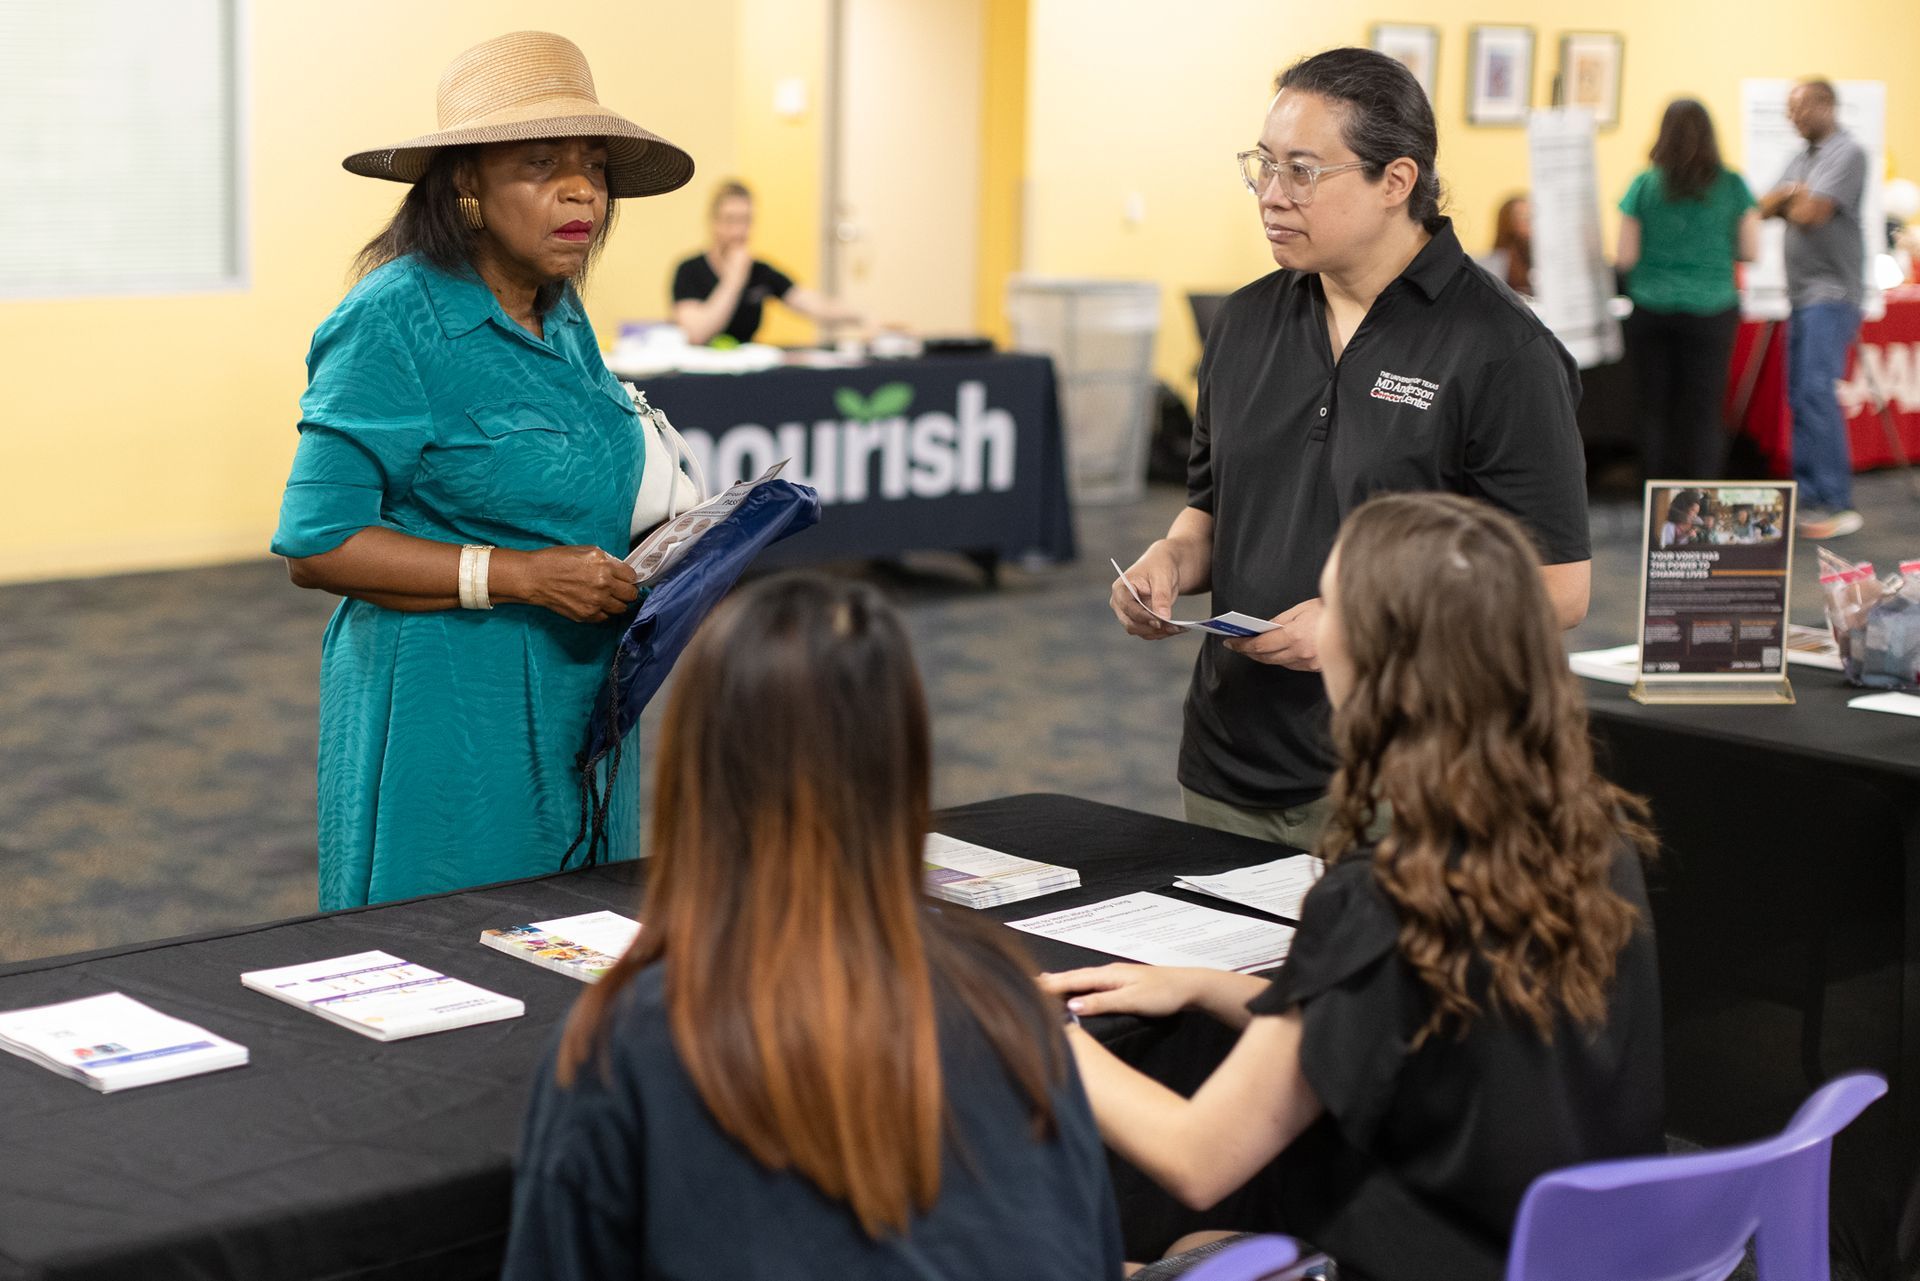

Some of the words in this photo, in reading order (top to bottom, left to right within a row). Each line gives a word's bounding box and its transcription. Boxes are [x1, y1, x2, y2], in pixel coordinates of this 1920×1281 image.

[1374, 377, 1395, 390] MD
[1392, 382, 1435, 401] Anderson
[1421, 379, 1440, 390] TEXAS
[1370, 387, 1403, 403] Cancer
[1400, 393, 1432, 410] Center
[1650, 551, 1674, 560] YOUR
[1650, 560, 1666, 569] THE
[1699, 560, 1711, 570] TO
